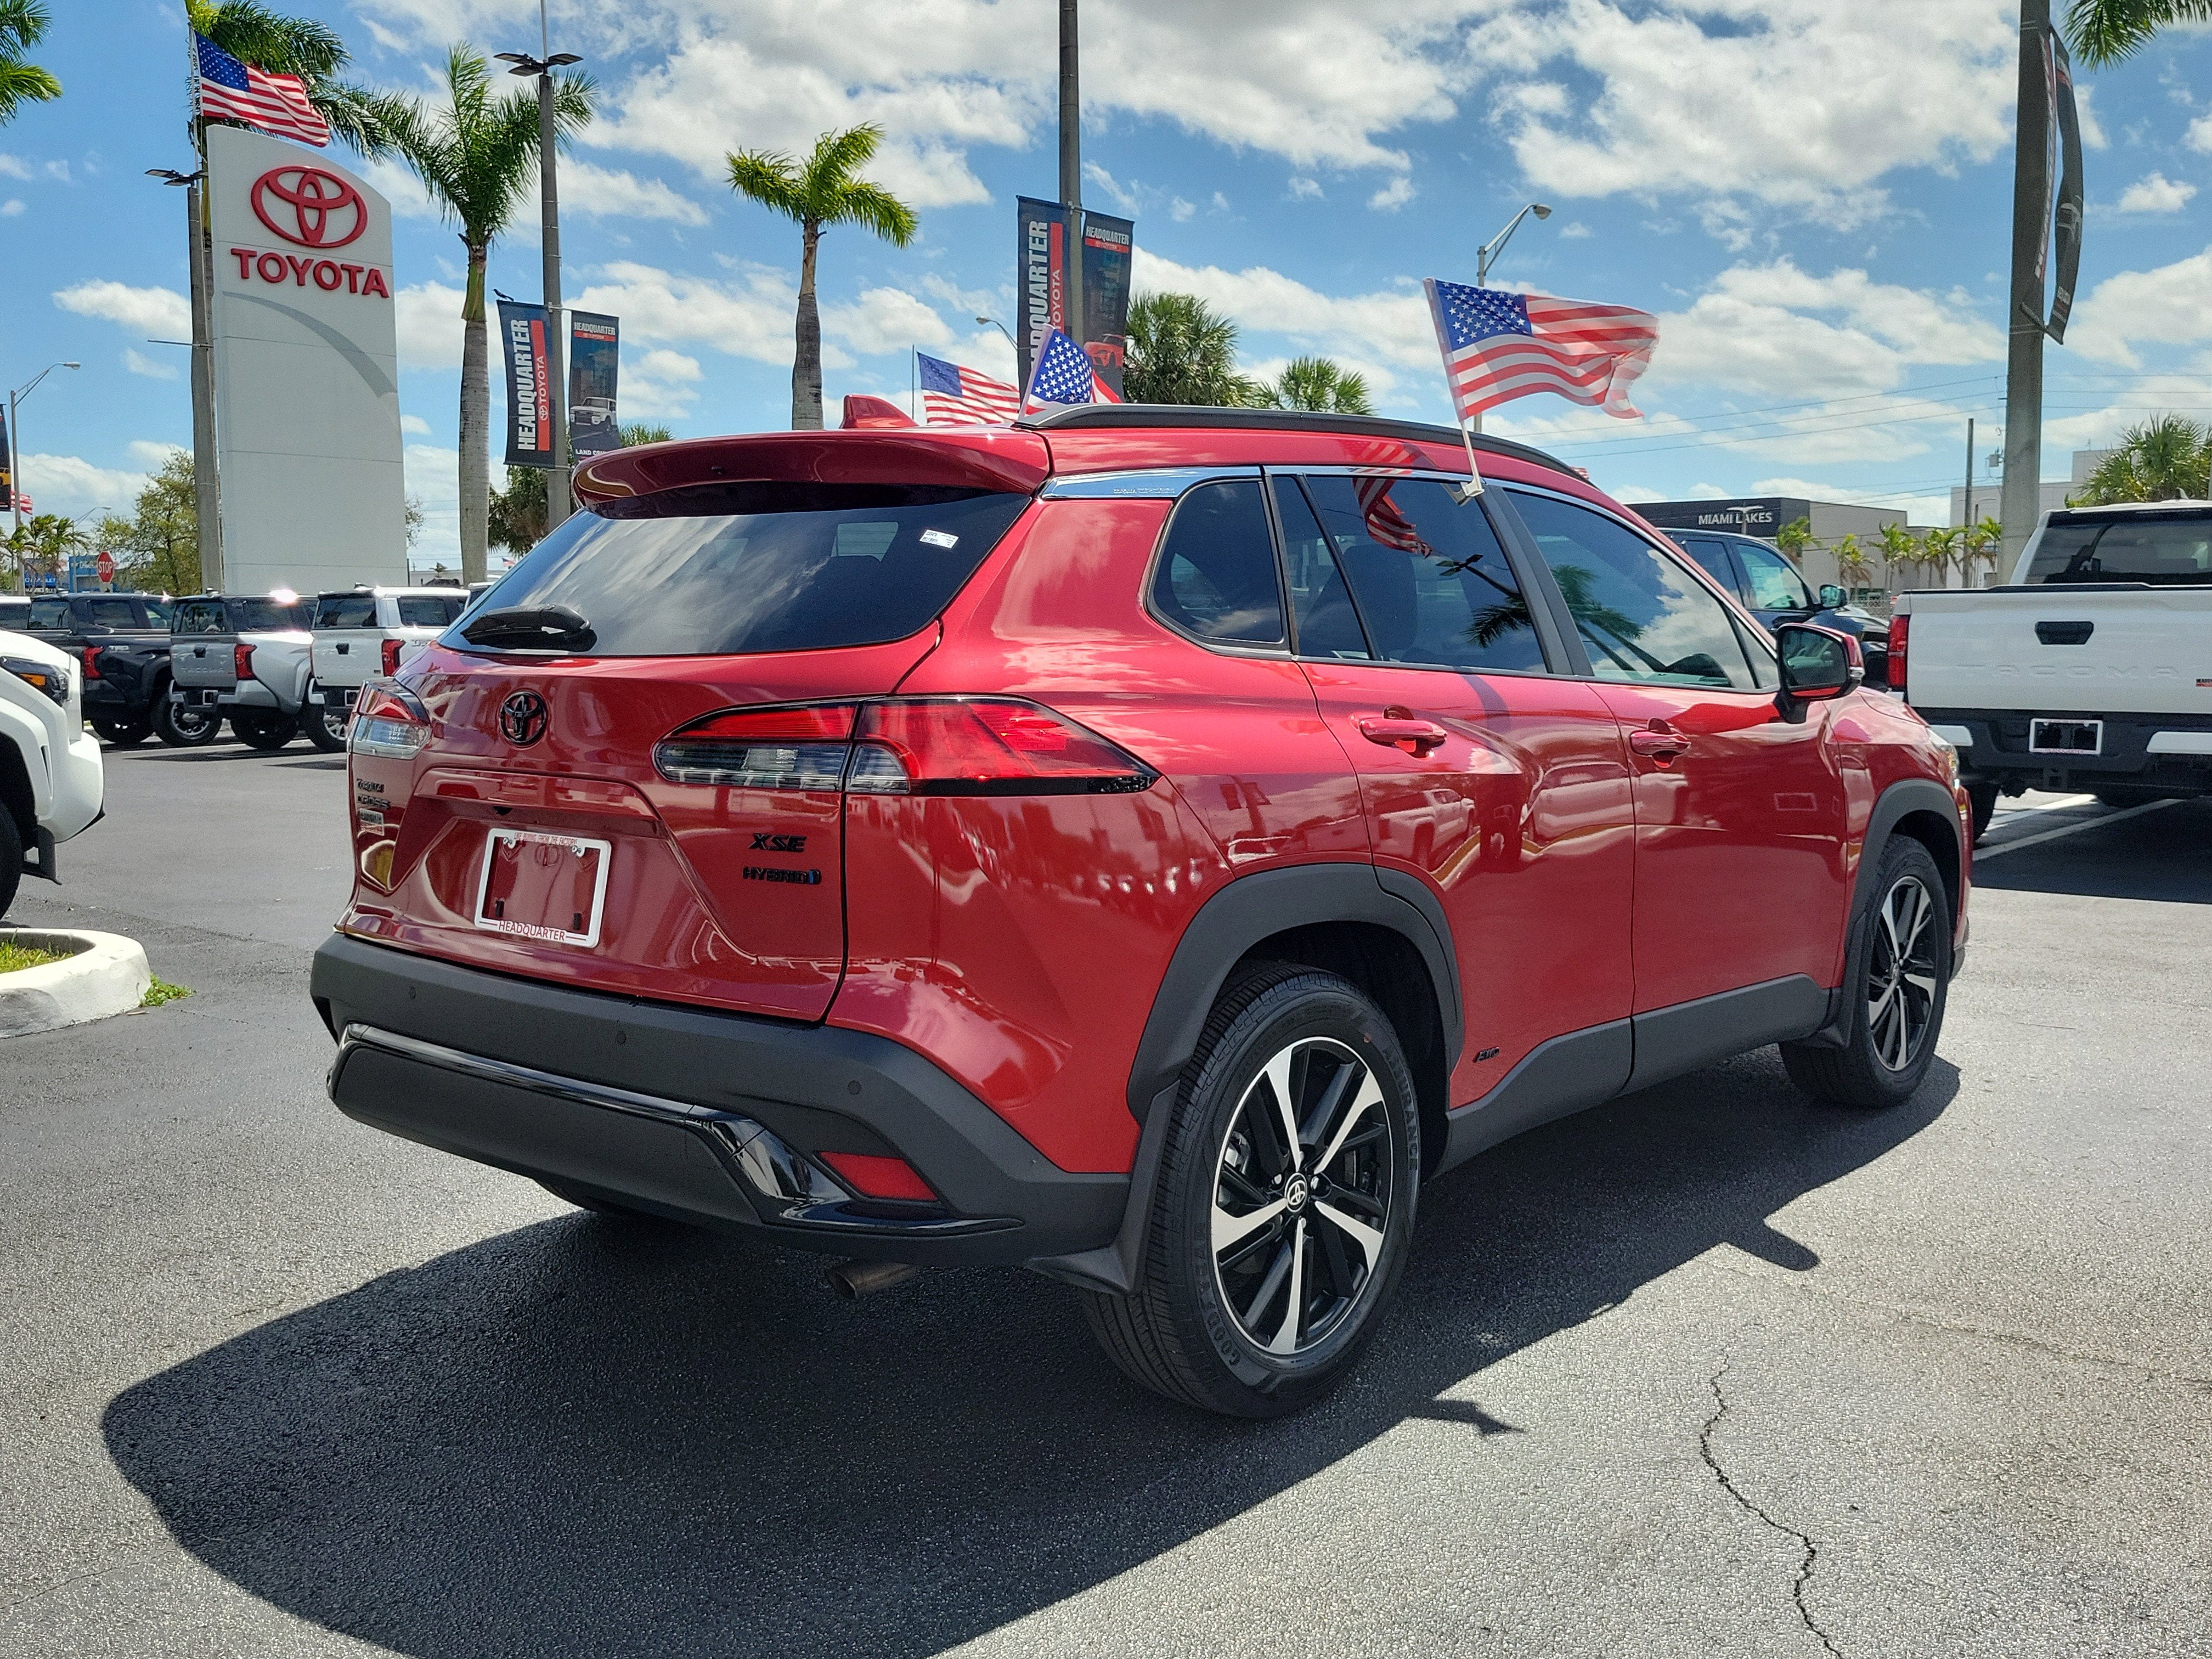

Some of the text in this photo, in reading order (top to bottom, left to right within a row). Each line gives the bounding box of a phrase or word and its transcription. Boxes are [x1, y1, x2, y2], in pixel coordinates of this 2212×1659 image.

[1086, 226, 1129, 245] HEADQUARTER
[231, 249, 389, 298] TOYOTA
[1052, 270, 1062, 329] TOYOTA
[574, 322, 616, 335] HEADQUARTER
[511, 320, 537, 450] HEADQUARTER
[537, 356, 547, 404] TOYOTA
[1699, 512, 1773, 525] MIAMI LAKES
[99, 561, 112, 573] STOP
[1955, 664, 2180, 679] TACOMA
[748, 833, 807, 853] XSE
[743, 866, 809, 884] HYBRID
[499, 921, 565, 941] HEADQUARTER
[1382, 1049, 1418, 1171] ASSURANCE
